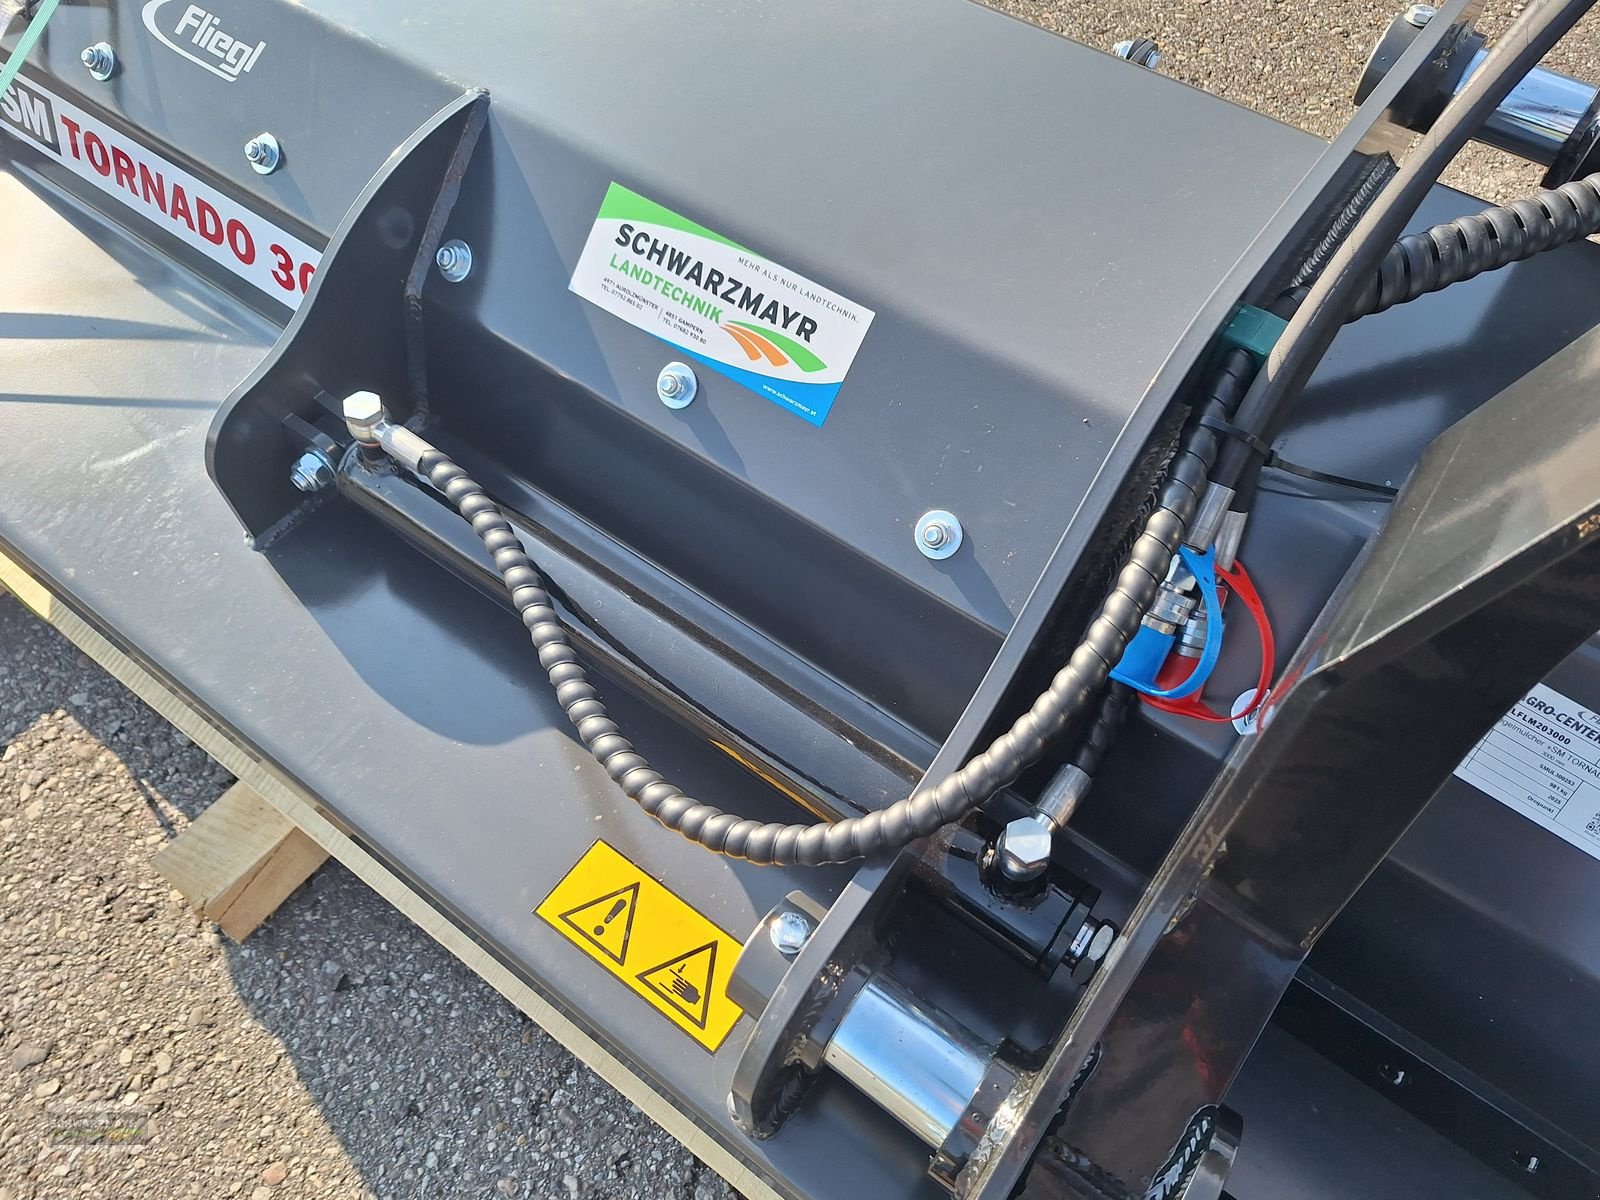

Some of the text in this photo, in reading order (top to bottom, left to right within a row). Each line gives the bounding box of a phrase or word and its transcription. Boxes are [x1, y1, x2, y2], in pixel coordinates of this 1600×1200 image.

[174, 4, 267, 74] Fliegl
[1, 85, 53, 143] SM
[60, 113, 256, 266] TORNADO
[609, 253, 724, 325] LANDTECHNIK
[614, 223, 818, 343] SCHWARZMAYR
[738, 257, 760, 272] MEHR
[763, 270, 778, 281] ALS
[780, 278, 798, 291] NUR
[678, 316, 704, 335] GAMPERN
[1501, 719, 1545, 746] gelmulcher
[1560, 787, 1568, 796] kg
